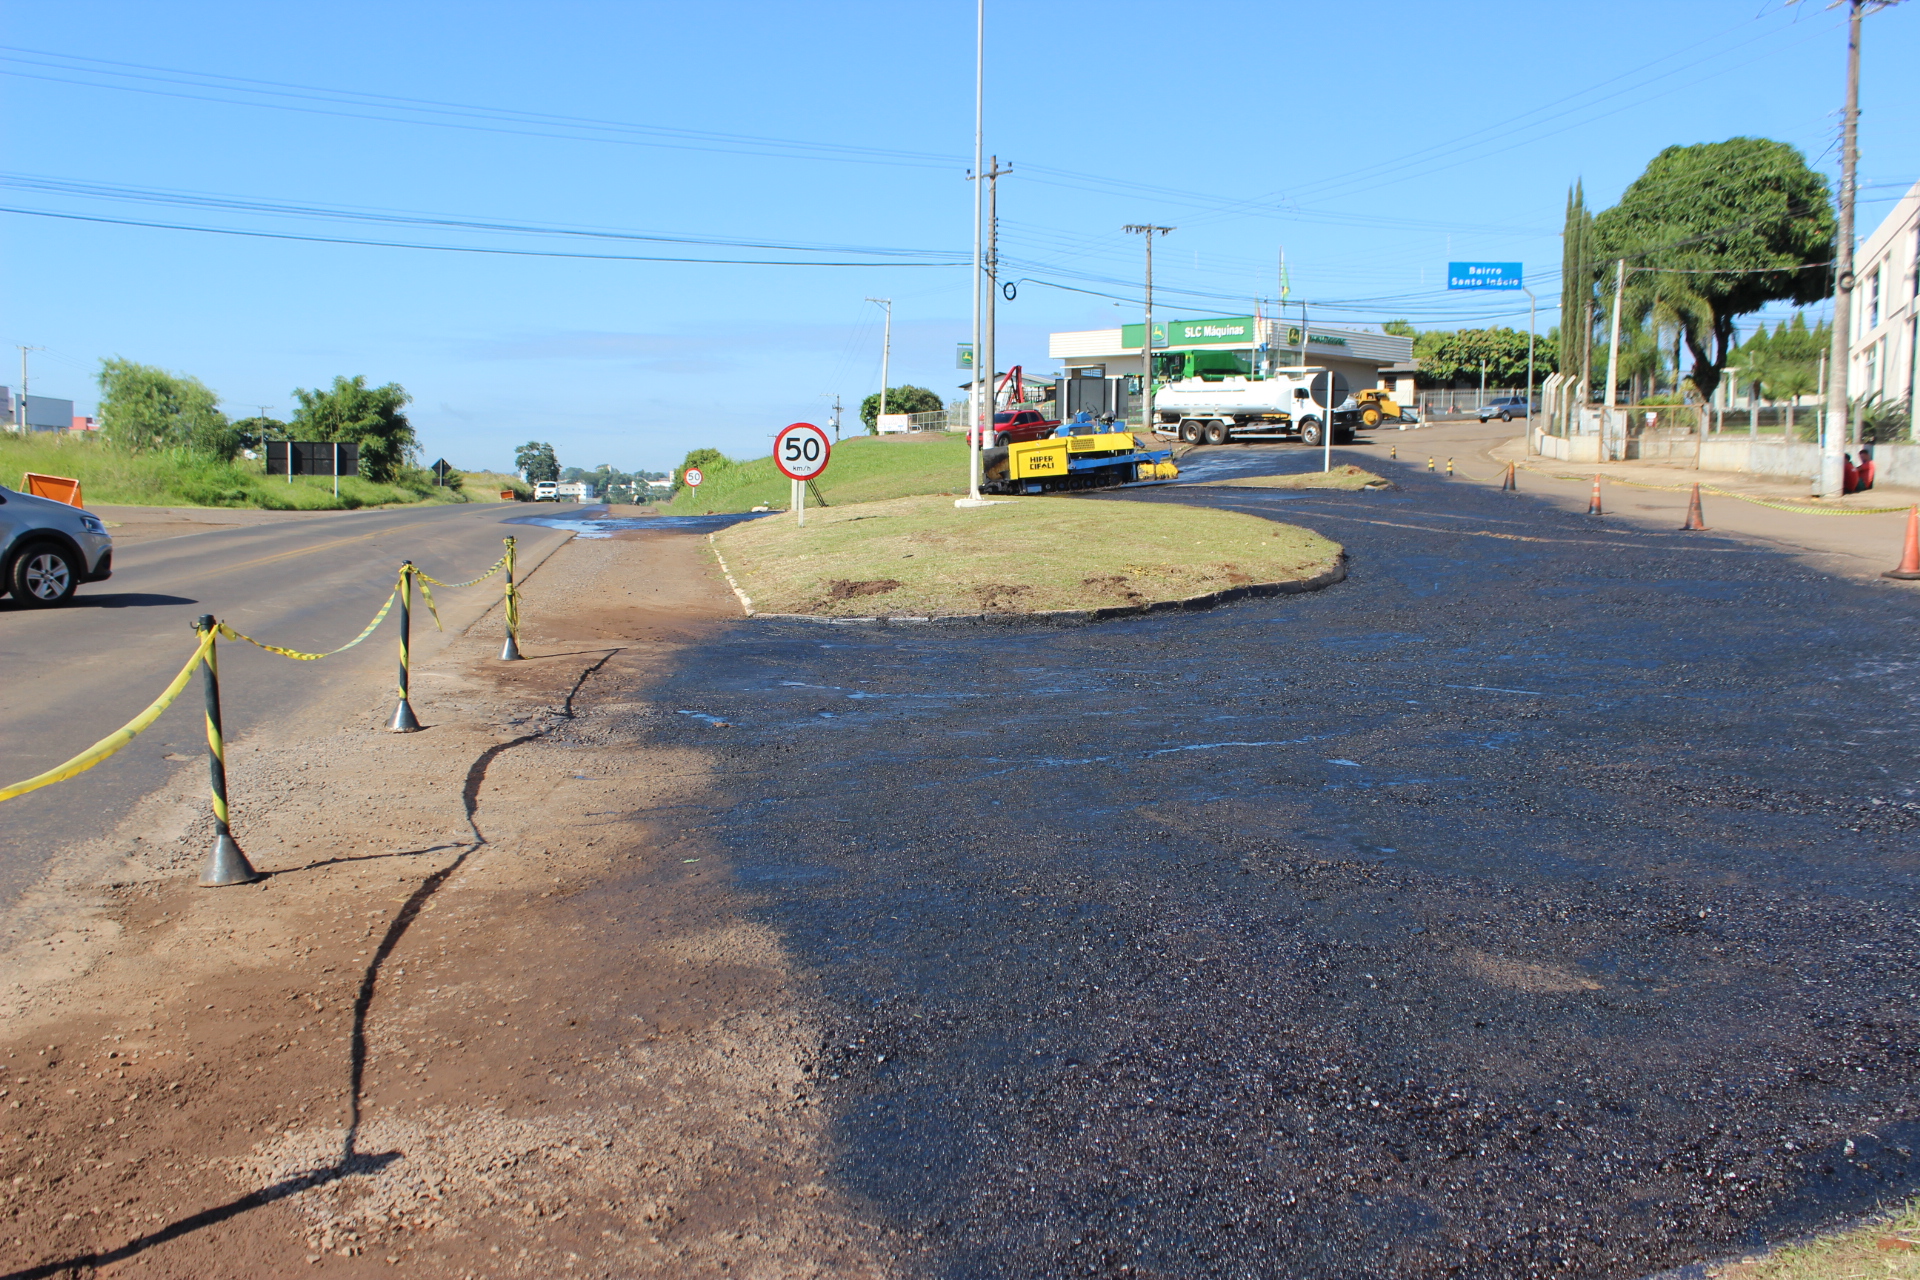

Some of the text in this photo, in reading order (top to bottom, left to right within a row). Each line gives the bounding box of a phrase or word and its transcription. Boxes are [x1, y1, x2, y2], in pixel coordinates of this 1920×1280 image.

[1469, 266, 1502, 275] Bairro
[1451, 277, 1482, 286] Santo
[1184, 324, 1245, 338] SLC Máquinas
[785, 437, 820, 462] 50
[1029, 455, 1054, 463] HIPER
[688, 472, 701, 481] 50
